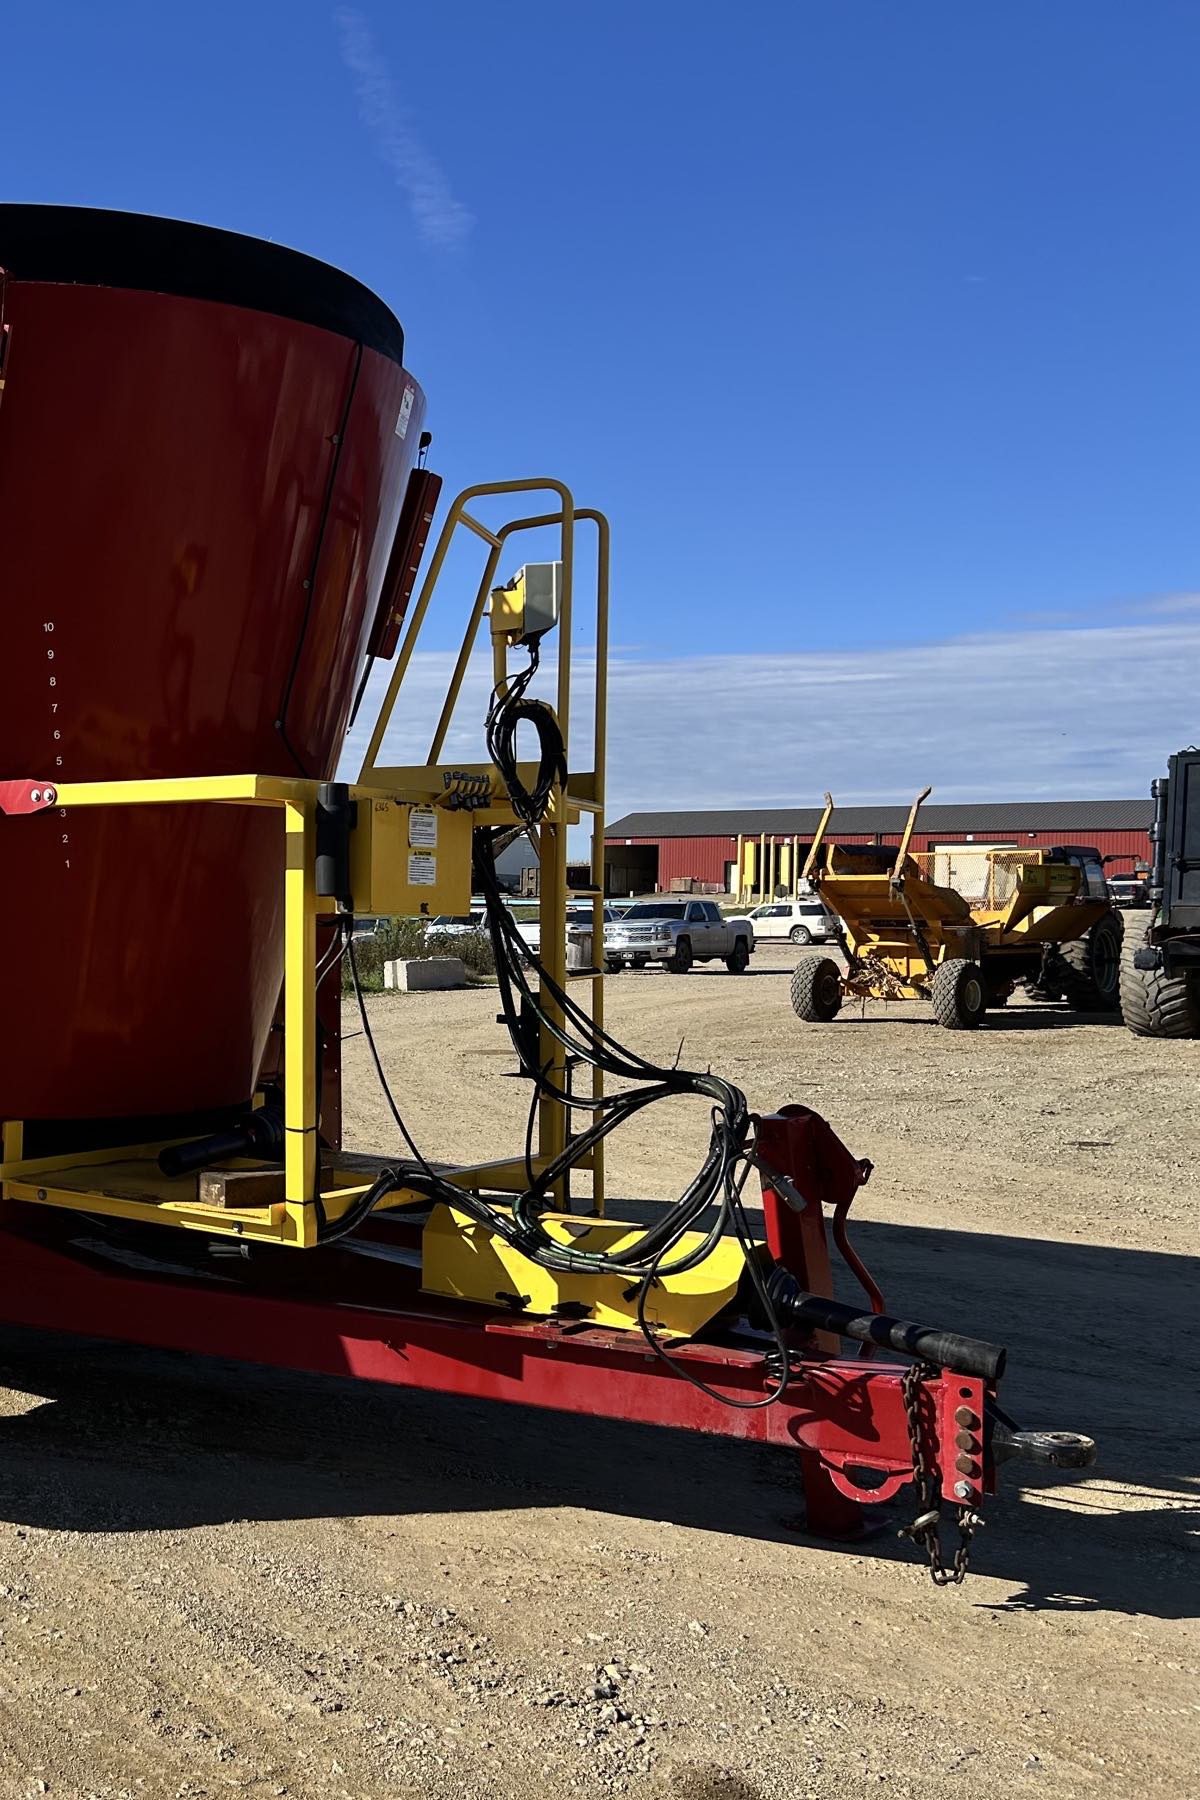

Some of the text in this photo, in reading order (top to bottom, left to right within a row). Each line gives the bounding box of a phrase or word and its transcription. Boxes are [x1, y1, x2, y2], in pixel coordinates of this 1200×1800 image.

[43, 623, 54, 632] 10
[47, 650, 54, 660] 9
[49, 677, 56, 687] 8
[51, 704, 57, 713] 7
[53, 730, 60, 740] 6
[56, 757, 62, 766] 5
[60, 809, 66, 818] 3
[62, 835, 68, 844] 2
[65, 860, 70, 869] 1
